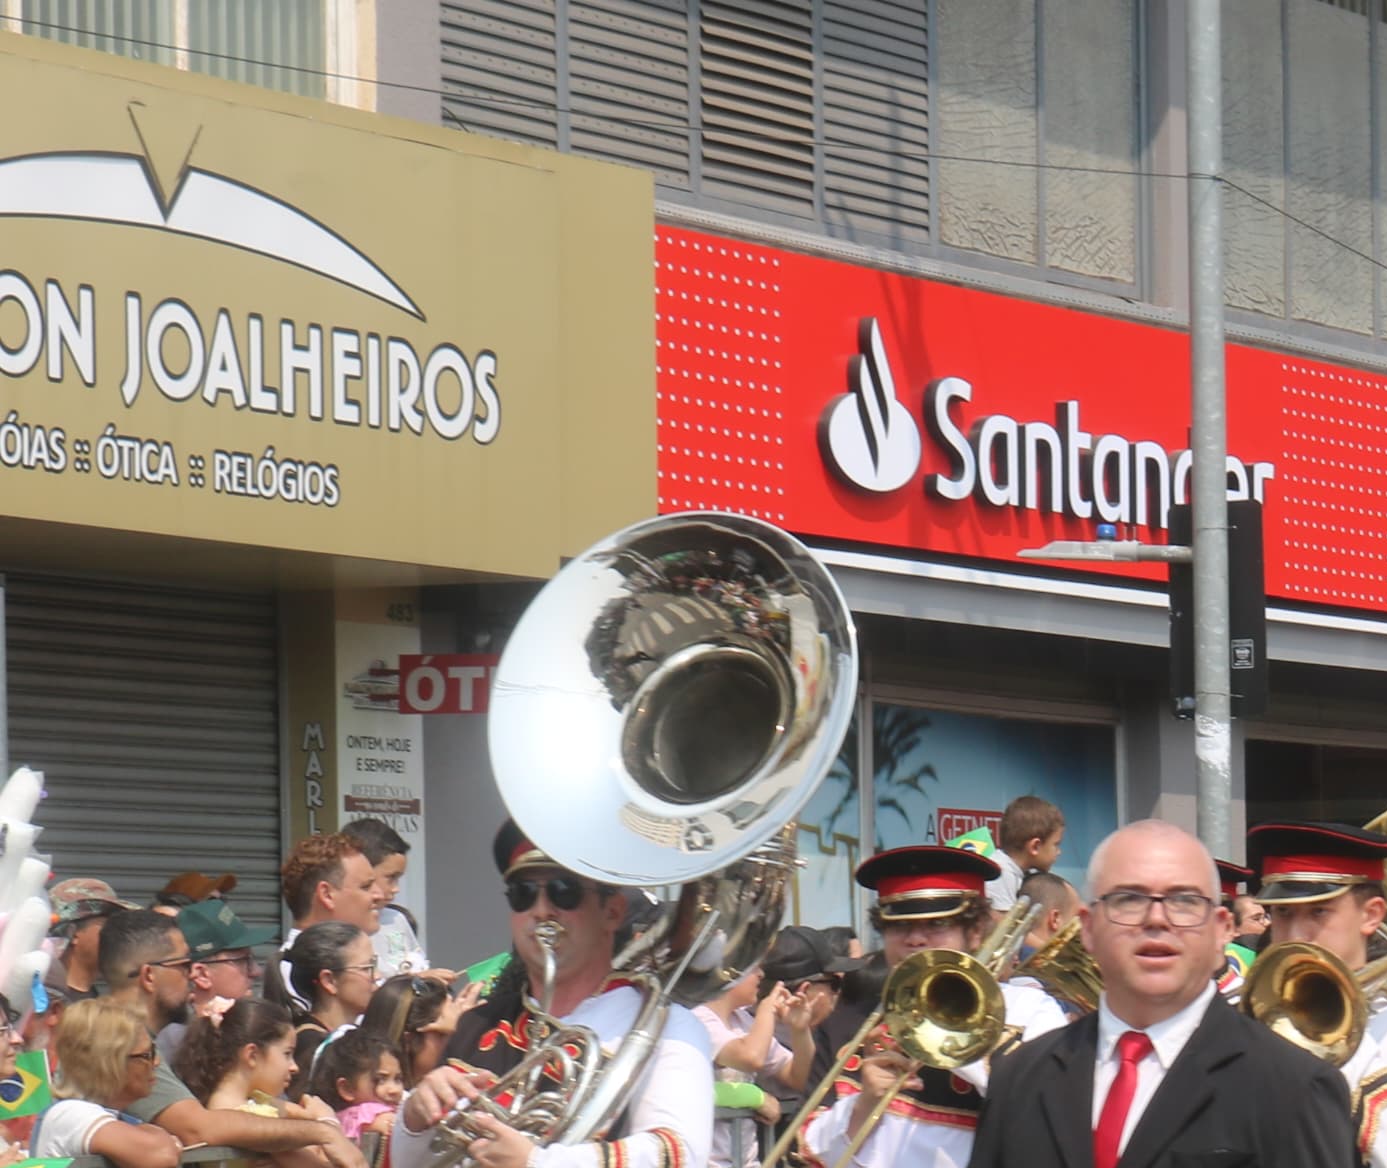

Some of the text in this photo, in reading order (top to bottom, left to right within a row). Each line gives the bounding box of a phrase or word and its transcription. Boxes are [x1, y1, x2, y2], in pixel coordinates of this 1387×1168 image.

[120, 290, 502, 445] JOALHEIROS
[96, 422, 179, 487] ÓTICA
[213, 445, 340, 507] RELÓGIOS
[386, 736, 411, 753] HOJE
